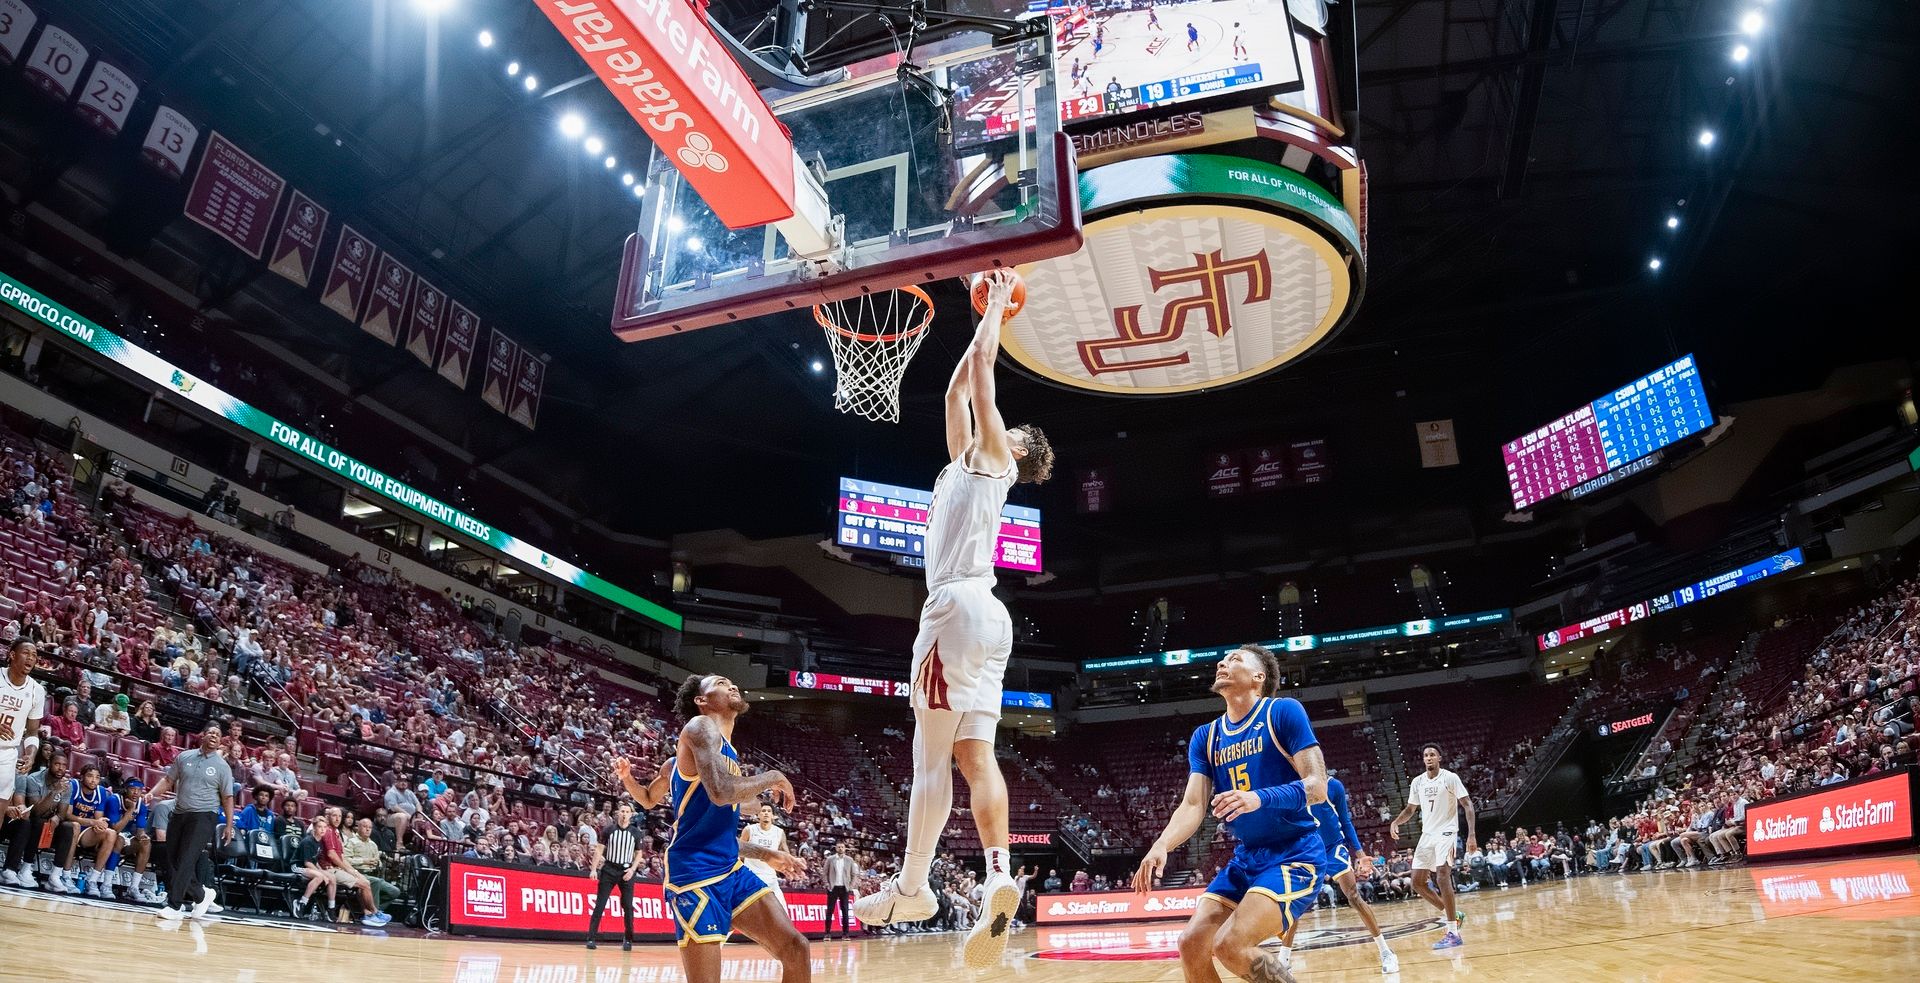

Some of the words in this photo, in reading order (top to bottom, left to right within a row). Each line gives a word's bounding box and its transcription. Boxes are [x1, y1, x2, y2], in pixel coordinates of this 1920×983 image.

[43, 46, 73, 75] 10
[553, 0, 695, 132] StateFar
[1146, 84, 1165, 100] 19
[1199, 80, 1226, 92] BONUS
[91, 80, 126, 112] 25
[1078, 97, 1098, 115] 29
[159, 127, 184, 154] 13
[214, 142, 250, 172] FLORIDA
[251, 166, 278, 190] STATE
[1228, 169, 1249, 181] FOR
[1250, 172, 1270, 185] ALL
[1270, 178, 1283, 188] OF
[1283, 181, 1307, 197] YOUR
[291, 224, 313, 240] NCAA
[0, 281, 95, 342] GPROCO.COM
[1648, 370, 1666, 385] THE
[1665, 357, 1692, 377] FLOOR
[1549, 418, 1566, 433] THE
[1565, 406, 1592, 426] FLOOR
[1209, 466, 1240, 480] ACC
[1253, 461, 1280, 474] ACC
[1572, 474, 1614, 497] FLORIDA
[1618, 455, 1653, 478] STATE
[270, 420, 298, 448] FOR
[300, 437, 325, 462] ALL
[328, 451, 348, 470] OF
[350, 460, 383, 490] YOUR
[384, 478, 455, 523] EQUIPMENT
[454, 513, 491, 541] NEEDS
[845, 514, 864, 526] OUT
[864, 517, 877, 528] OF
[916, 512, 920, 520] 1
[1705, 568, 1743, 587] BAKERSFIELD
[1718, 580, 1737, 592] BONUS
[1680, 586, 1694, 603] 19
[1580, 616, 1602, 630] FLORIDA
[1601, 611, 1619, 623] STATE
[1628, 603, 1645, 621] 29
[841, 676, 864, 686] FLORIDA
[864, 678, 884, 688] STATE
[894, 682, 910, 697] 29
[1, 694, 24, 709] FSU
[1611, 712, 1654, 733] SEATGEEK
[1228, 762, 1251, 792] 15
[1424, 786, 1439, 794] FSU
[1428, 799, 1435, 813] 7
[477, 878, 502, 892] FARM
[468, 889, 503, 903] BUREAU
[520, 887, 584, 915] PROUD
[587, 894, 663, 919] SOSOR
